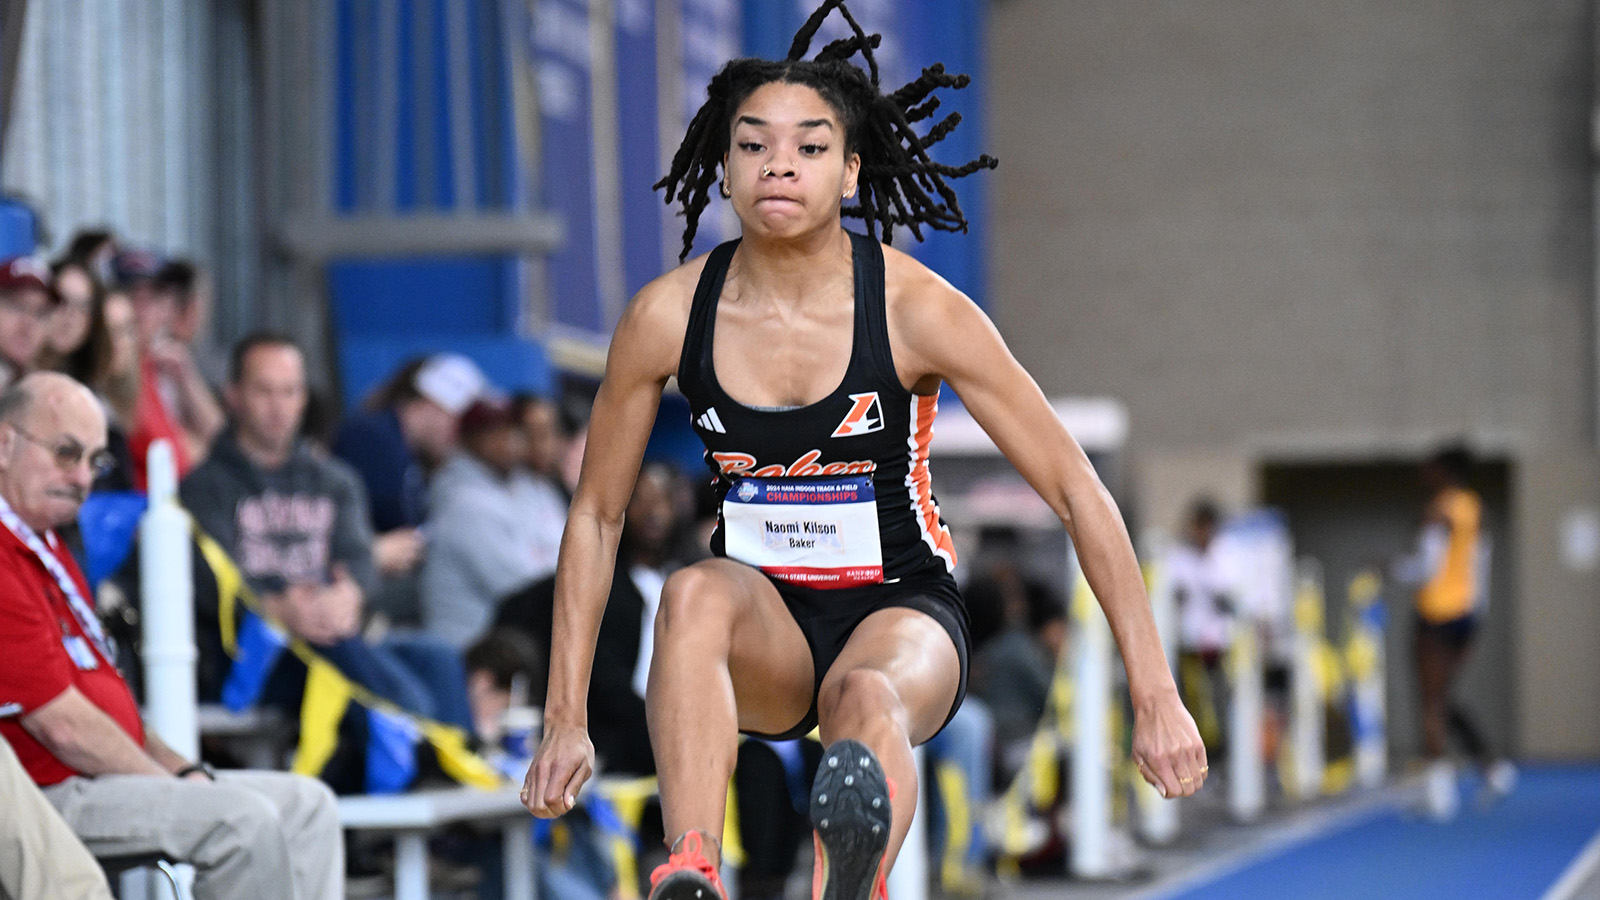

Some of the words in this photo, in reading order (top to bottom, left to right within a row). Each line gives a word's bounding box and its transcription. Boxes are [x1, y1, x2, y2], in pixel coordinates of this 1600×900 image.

[766, 491, 858, 502] CHAMPIONSHIPS
[765, 520, 800, 534] Naomi
[803, 521, 837, 534] Kilson
[789, 538, 816, 549] Baker
[789, 573, 807, 581] STATE
[807, 574, 841, 582] UNIVERSITY
